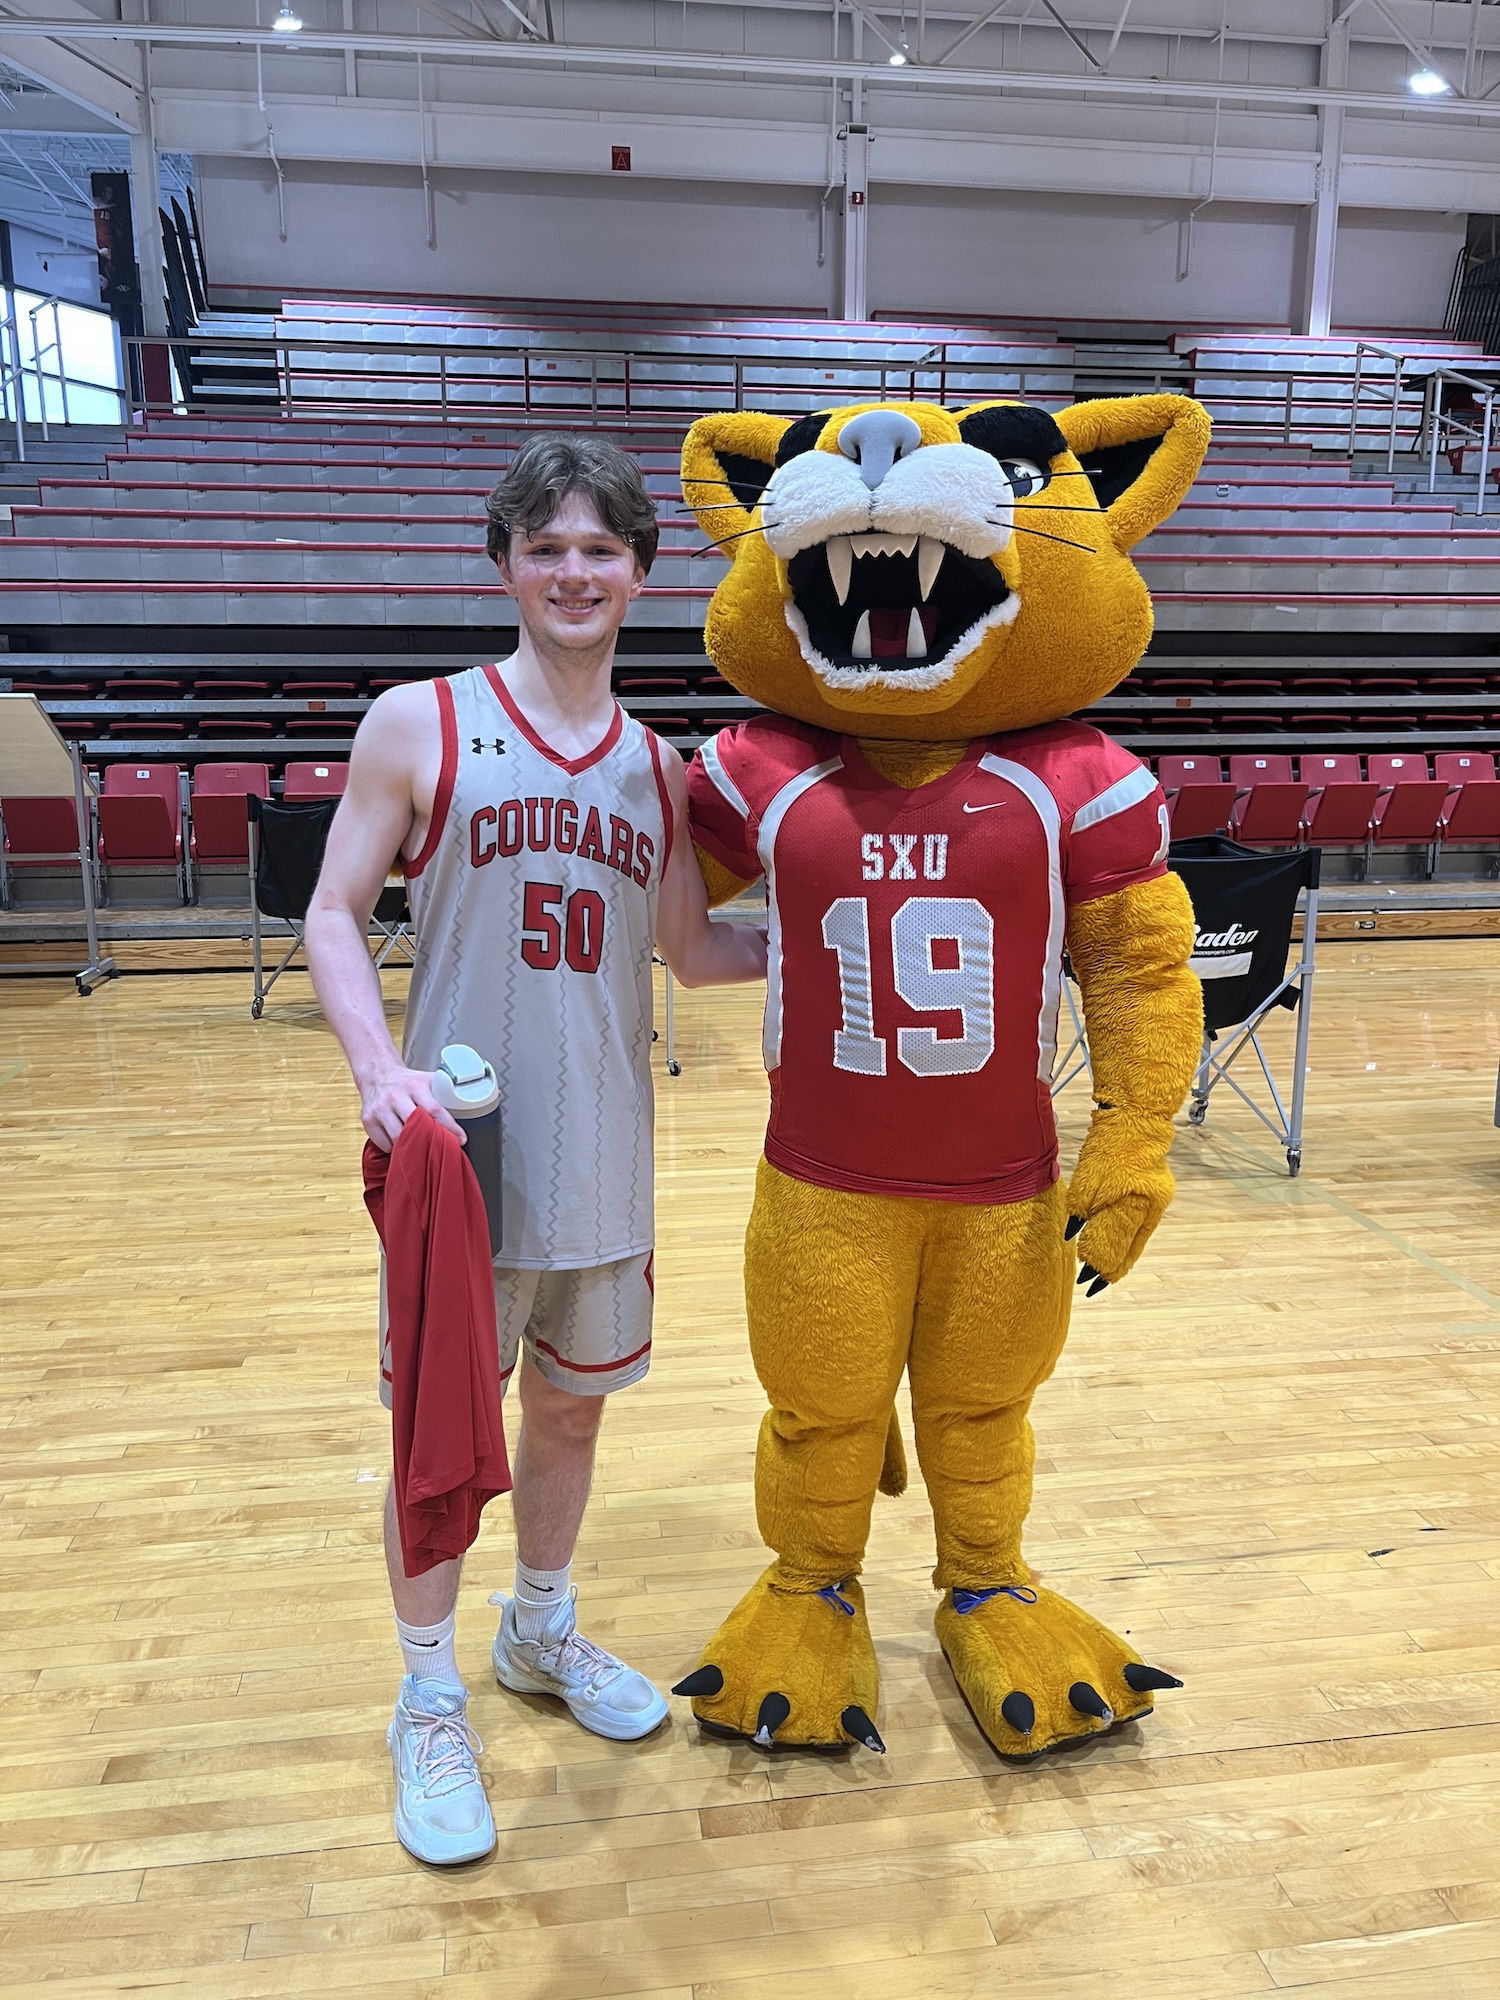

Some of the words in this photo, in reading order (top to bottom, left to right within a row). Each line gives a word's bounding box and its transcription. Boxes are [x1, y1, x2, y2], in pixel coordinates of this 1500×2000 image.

[615, 153, 628, 169] A
[470, 797, 655, 891] COUGARS
[860, 833, 949, 881] SXU
[520, 881, 606, 975] 50
[820, 896, 995, 1077] 19
